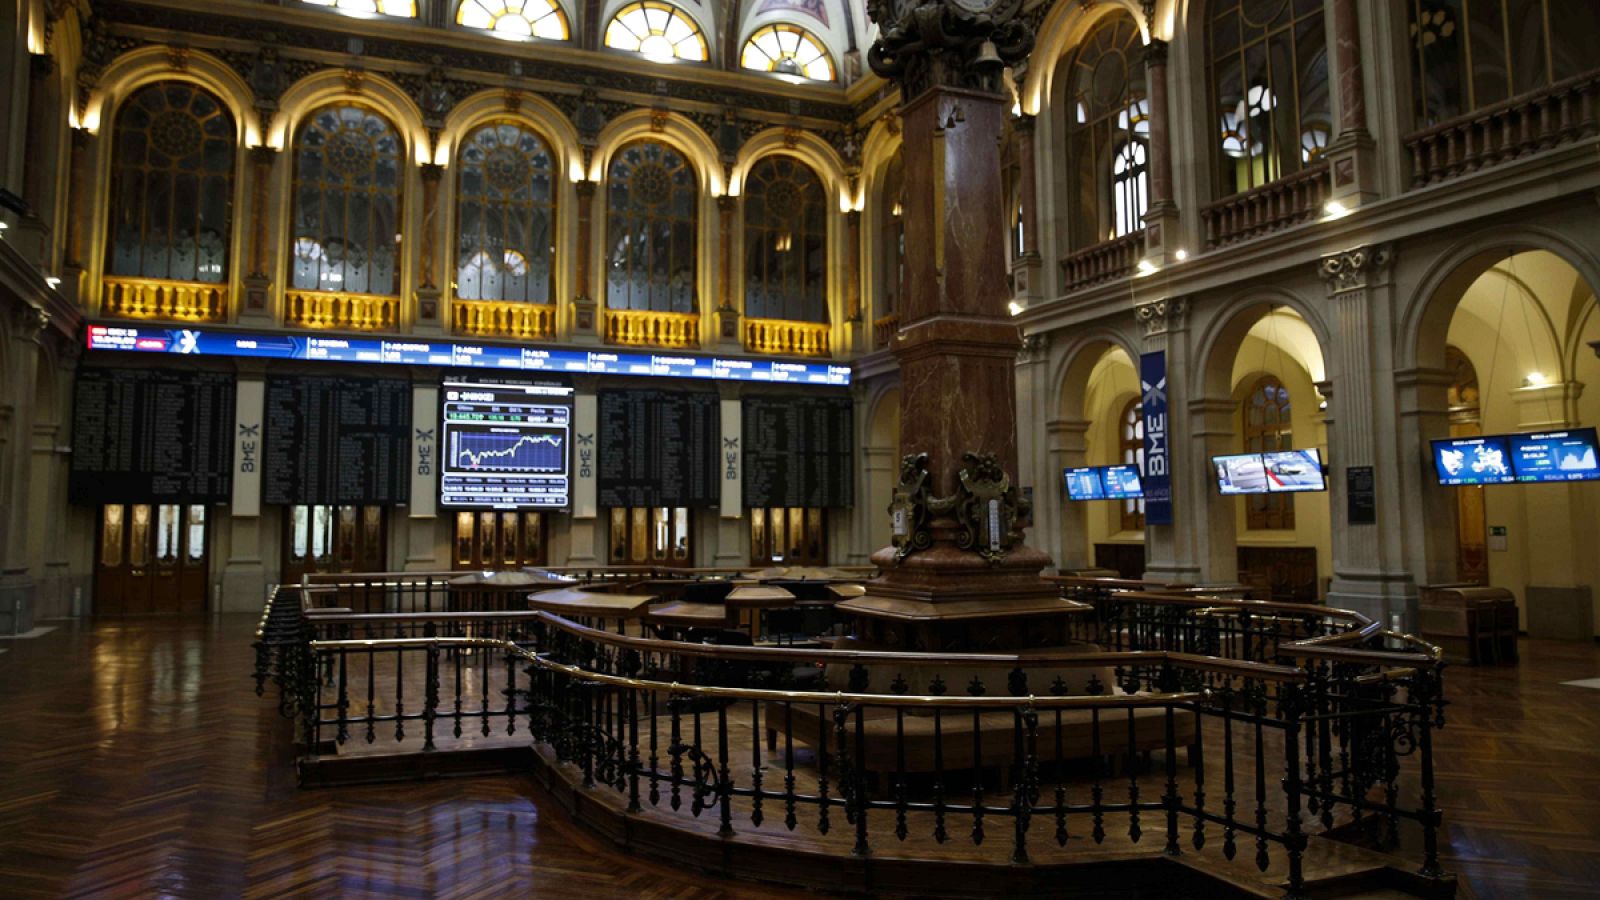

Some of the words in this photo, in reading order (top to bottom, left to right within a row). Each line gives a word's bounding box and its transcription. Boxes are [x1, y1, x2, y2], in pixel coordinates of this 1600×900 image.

[241, 439, 255, 472] BME
[1147, 412, 1165, 477] BME
[418, 445, 430, 475] BME
[580, 448, 591, 477] BME
[726, 452, 737, 480] BME
